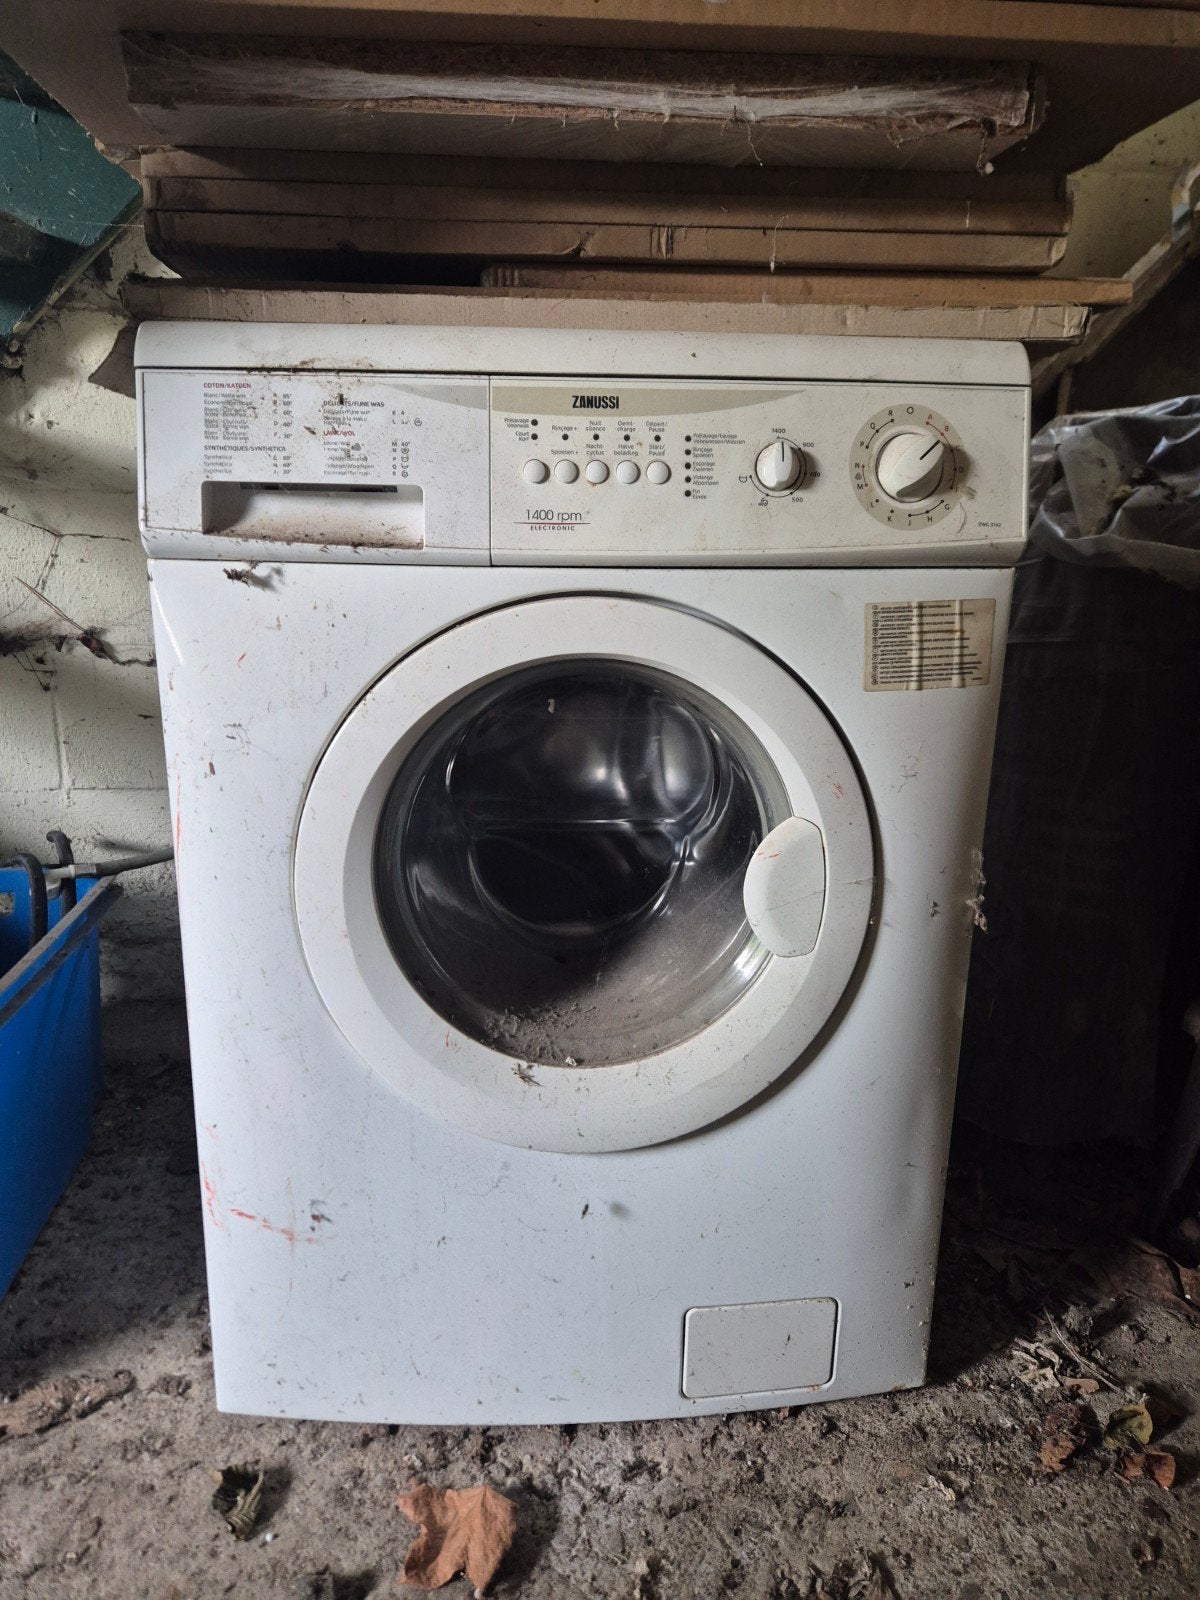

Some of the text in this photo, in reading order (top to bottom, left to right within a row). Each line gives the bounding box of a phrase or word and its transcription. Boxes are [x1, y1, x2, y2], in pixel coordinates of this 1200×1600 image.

[572, 395, 619, 409] ZANUSSI
[526, 509, 582, 523] 1400 rpm
